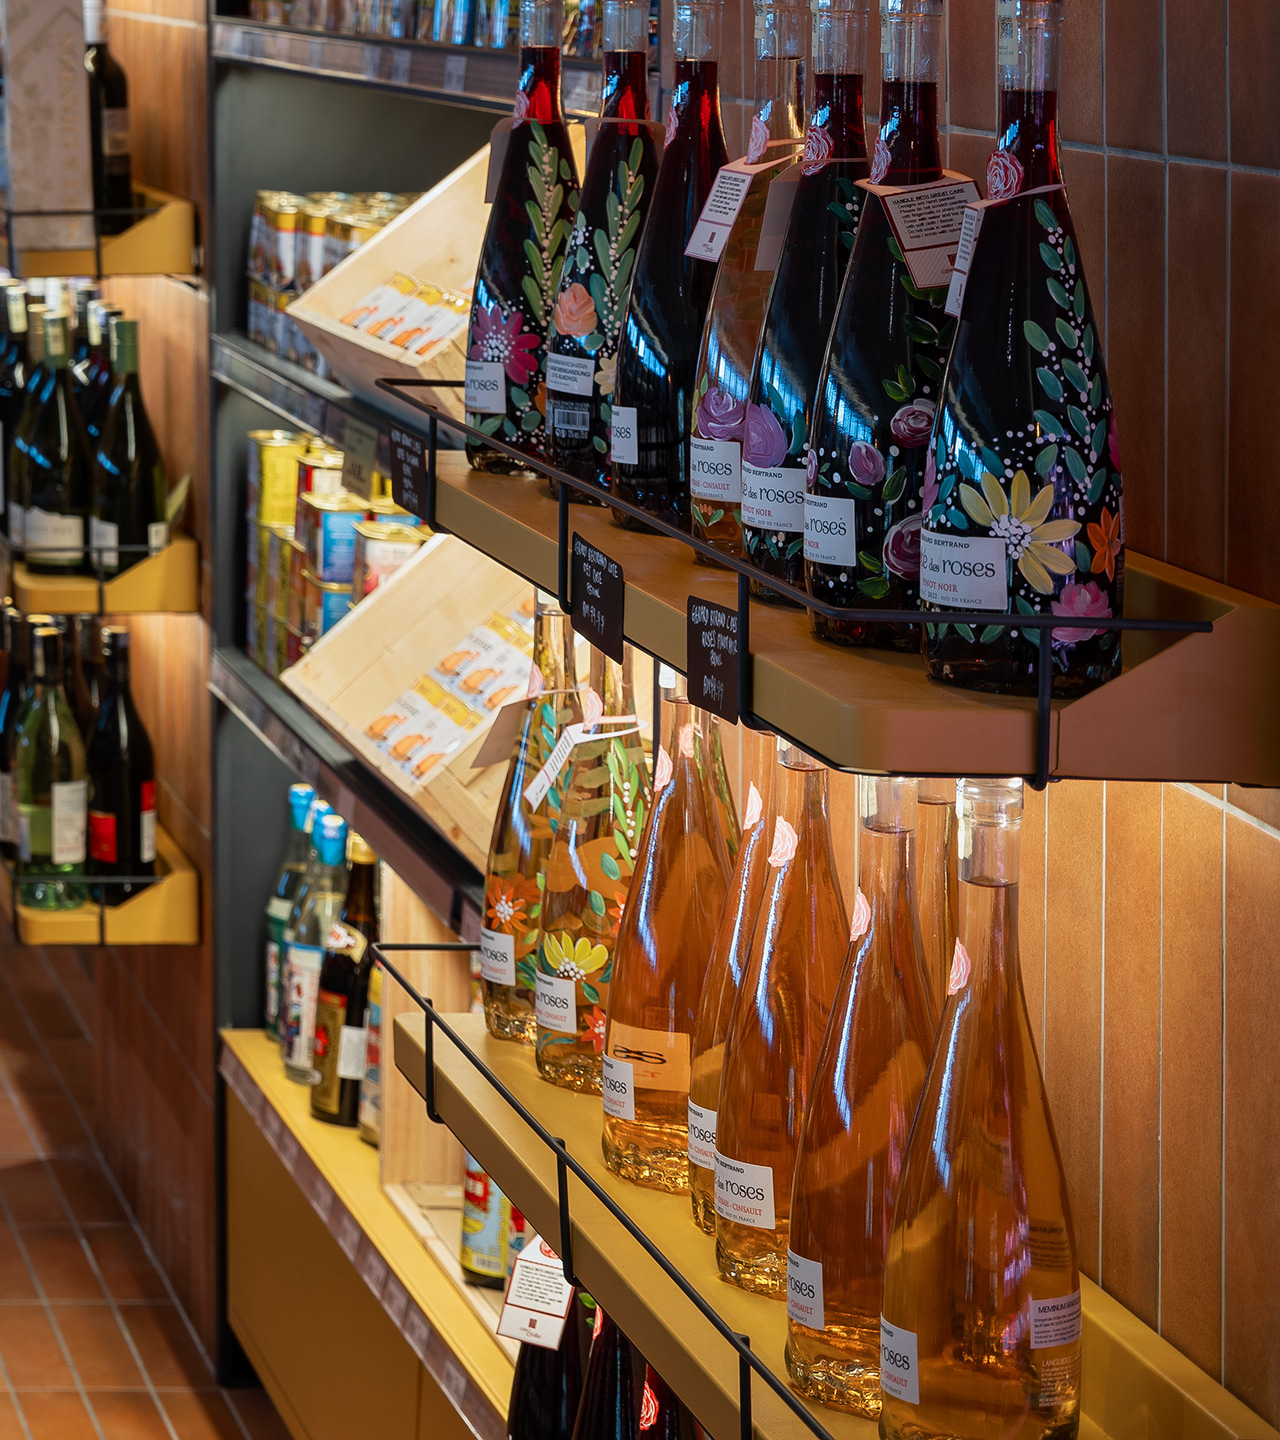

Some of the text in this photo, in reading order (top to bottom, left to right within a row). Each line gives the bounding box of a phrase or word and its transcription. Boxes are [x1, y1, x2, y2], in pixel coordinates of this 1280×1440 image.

[892, 197, 914, 205] HANDLE
[697, 459, 733, 476] roses
[752, 468, 783, 479] BERTRAND
[759, 487, 805, 504] roses
[755, 507, 773, 518] NOIR
[933, 539, 970, 549] BERTRAND
[928, 558, 940, 573] des
[942, 559, 996, 578] roses
[938, 581, 959, 593] NOIR
[540, 992, 569, 1010] roses
[725, 1179, 765, 1201] roses
[731, 1203, 763, 1216] CINSAULT
